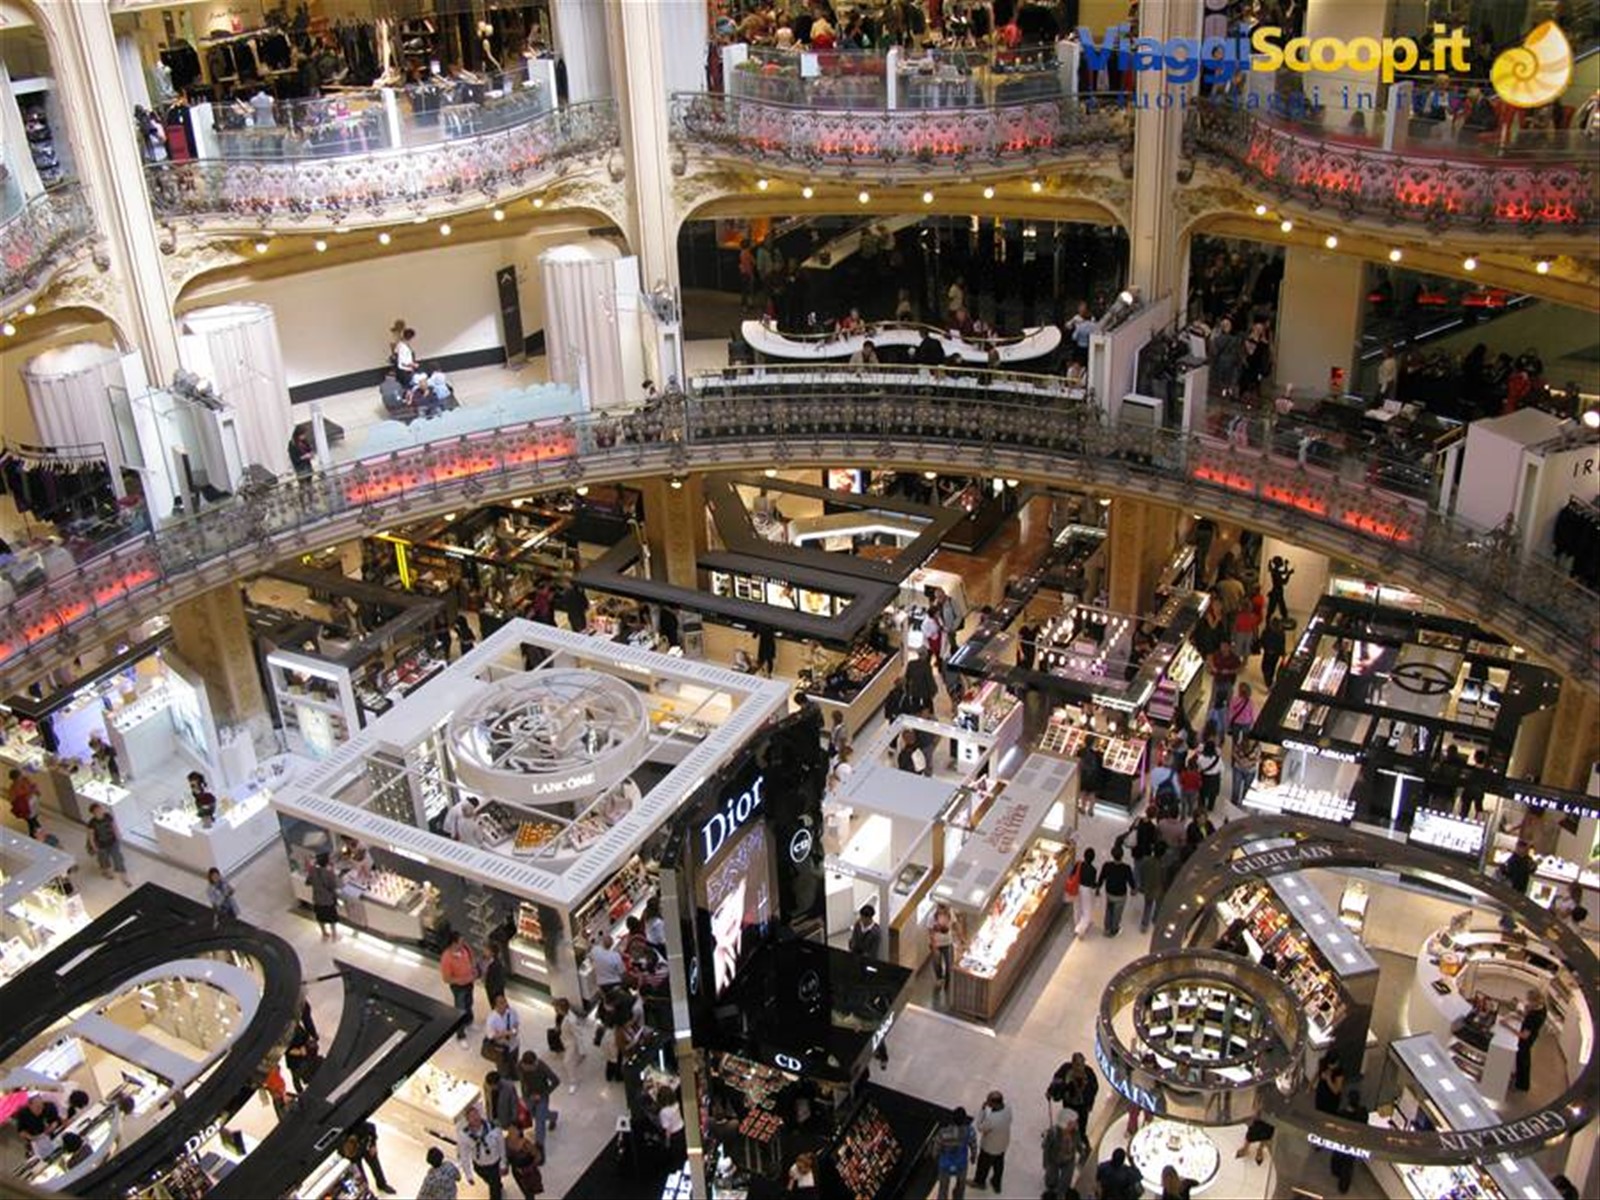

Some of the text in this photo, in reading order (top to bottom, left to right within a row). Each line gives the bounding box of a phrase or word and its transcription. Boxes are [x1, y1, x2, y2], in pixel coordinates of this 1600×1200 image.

[1573, 459, 1600, 478] IR
[1282, 739, 1319, 755] GIORGIO
[1513, 792, 1557, 811] RALPH
[702, 775, 763, 865] Dior
[1231, 845, 1334, 875] GUERLAIN
[775, 1053, 802, 1071] CD
[184, 1119, 221, 1156] Dior
[1438, 1110, 1566, 1151] GUERLAIN
[1307, 1133, 1371, 1159] GUERLAIN
